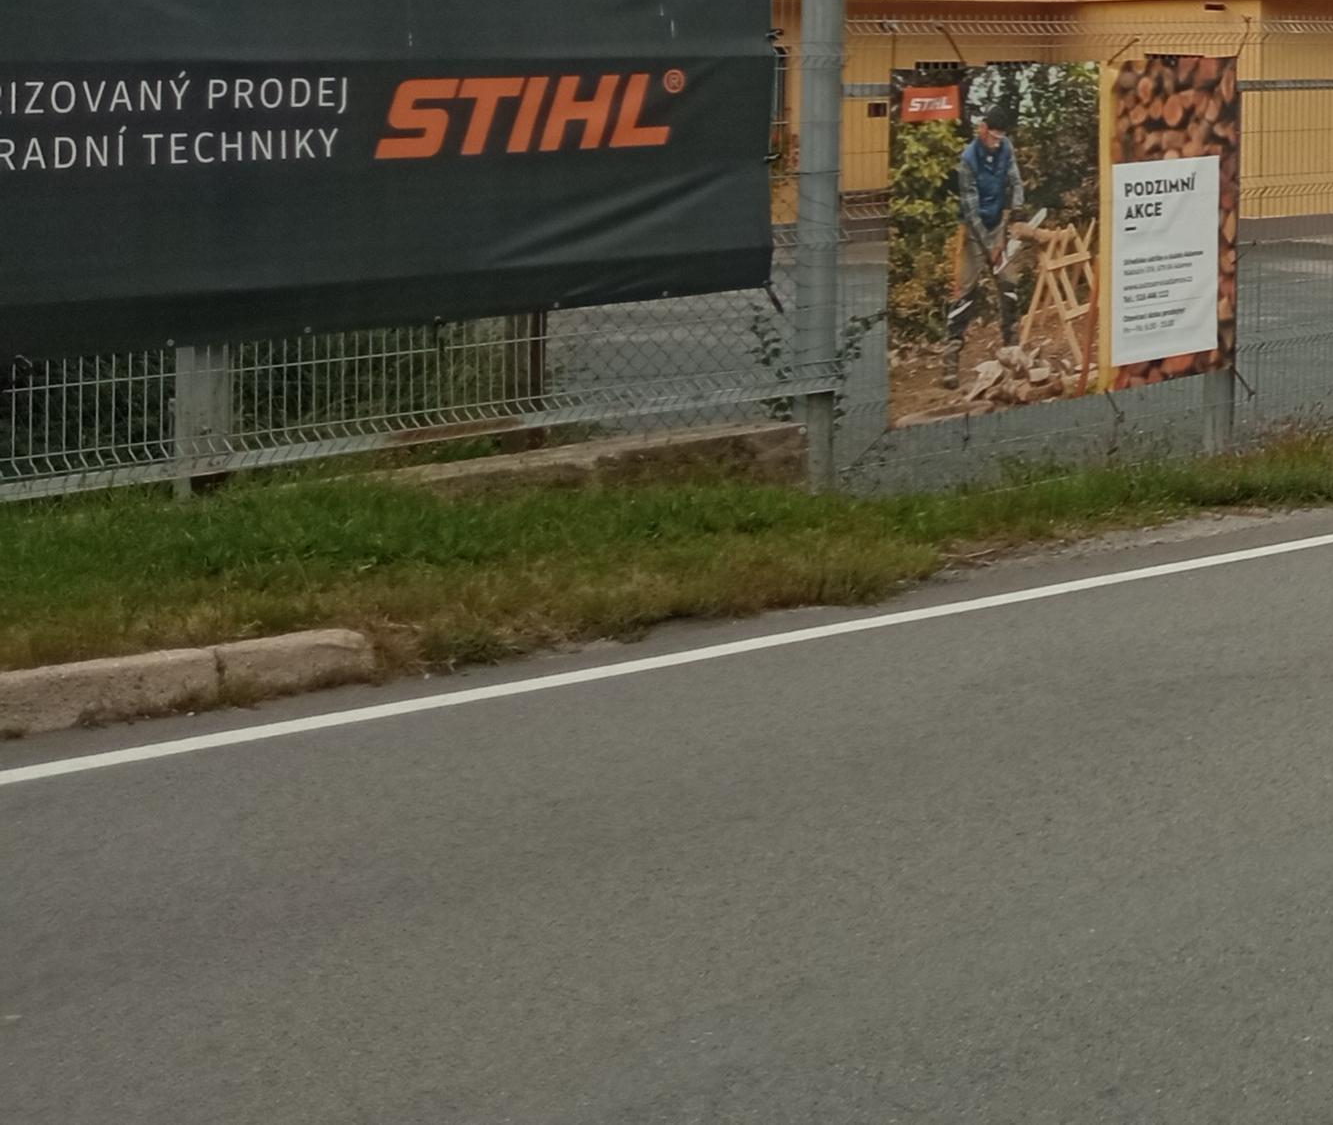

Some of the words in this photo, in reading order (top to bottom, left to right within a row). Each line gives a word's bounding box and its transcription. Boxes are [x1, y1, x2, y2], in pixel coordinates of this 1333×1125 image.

[0, 70, 191, 115] IZOVANÝ
[207, 77, 348, 114] PRODEJ
[374, 74, 671, 159] STIHL
[142, 127, 339, 165] TECHNIKY
[1124, 172, 1197, 198] PODZIMNÍ
[1124, 202, 1163, 220] AKCE
